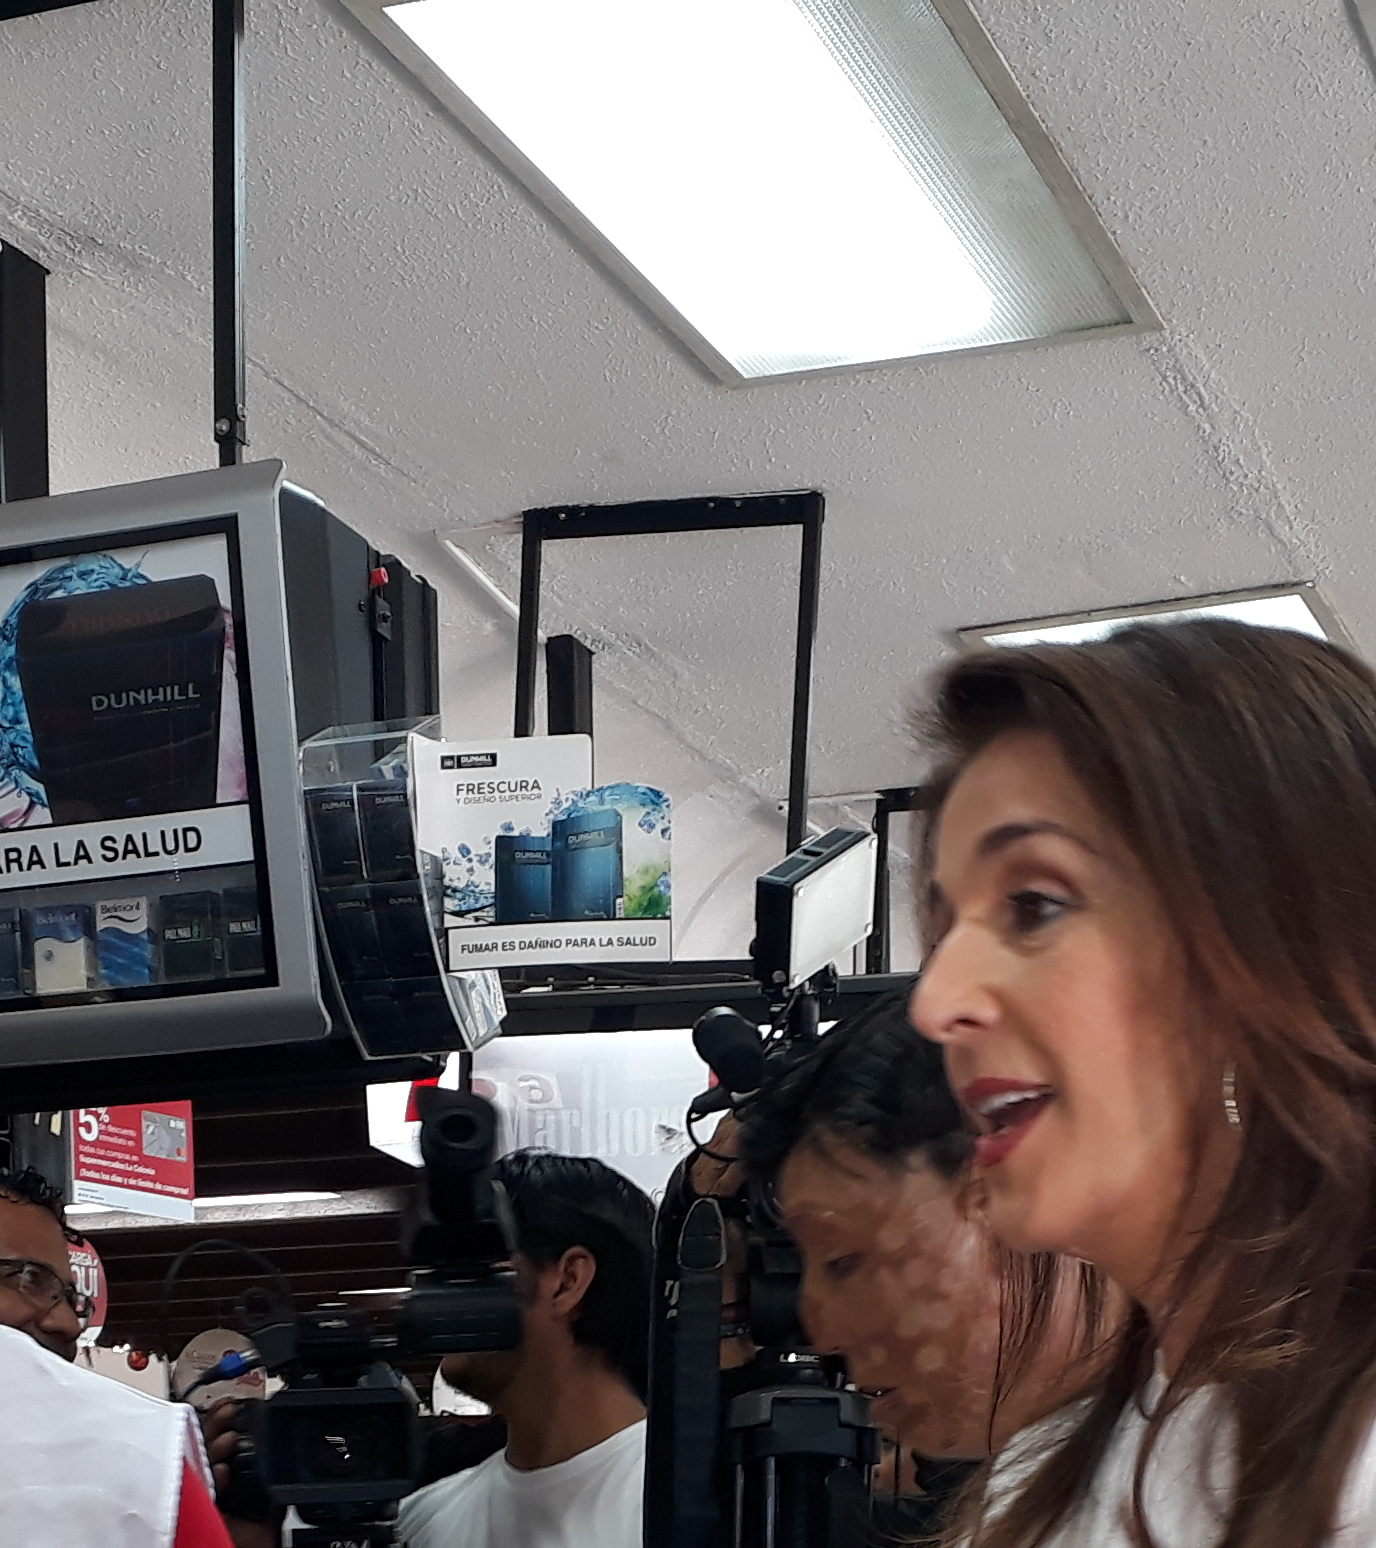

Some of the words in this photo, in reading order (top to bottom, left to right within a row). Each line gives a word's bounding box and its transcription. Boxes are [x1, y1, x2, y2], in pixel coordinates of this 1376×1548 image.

[91, 682, 201, 712] DUNHILL
[456, 779, 542, 796] FRESCURA
[54, 839, 93, 868] LA
[100, 825, 202, 863] SALUD
[461, 941, 499, 955] FUMAR
[501, 940, 516, 951] ES
[518, 935, 563, 951] DAÑINO
[565, 938, 597, 949] PARA
[598, 938, 614, 948] LA
[616, 935, 657, 948] SALUD
